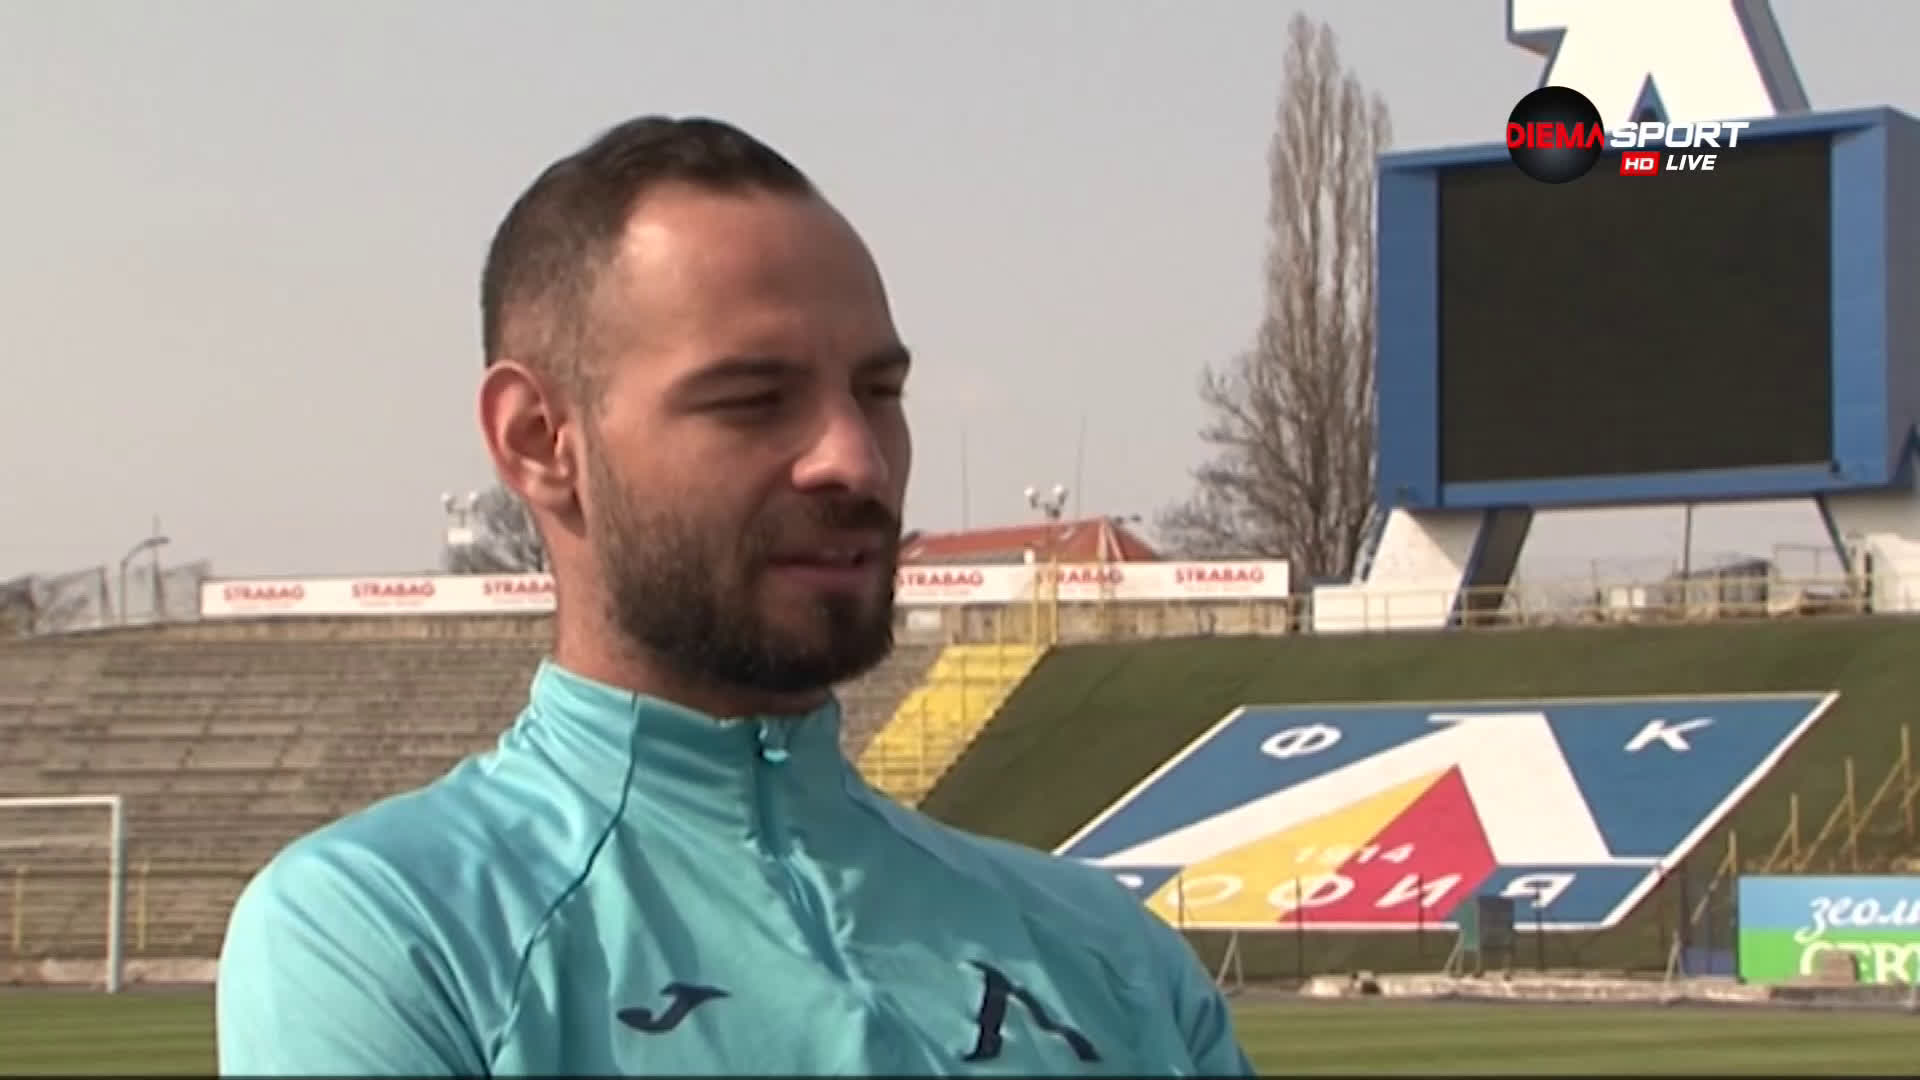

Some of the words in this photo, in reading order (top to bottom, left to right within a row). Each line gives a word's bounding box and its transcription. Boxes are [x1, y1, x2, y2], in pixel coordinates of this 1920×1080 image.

[1175, 567, 1265, 584] STRABAG
[223, 582, 305, 601] STRABAG
[352, 580, 436, 598] STRABAG
[483, 577, 555, 596] STRABA
[1261, 723, 1342, 759] Ф
